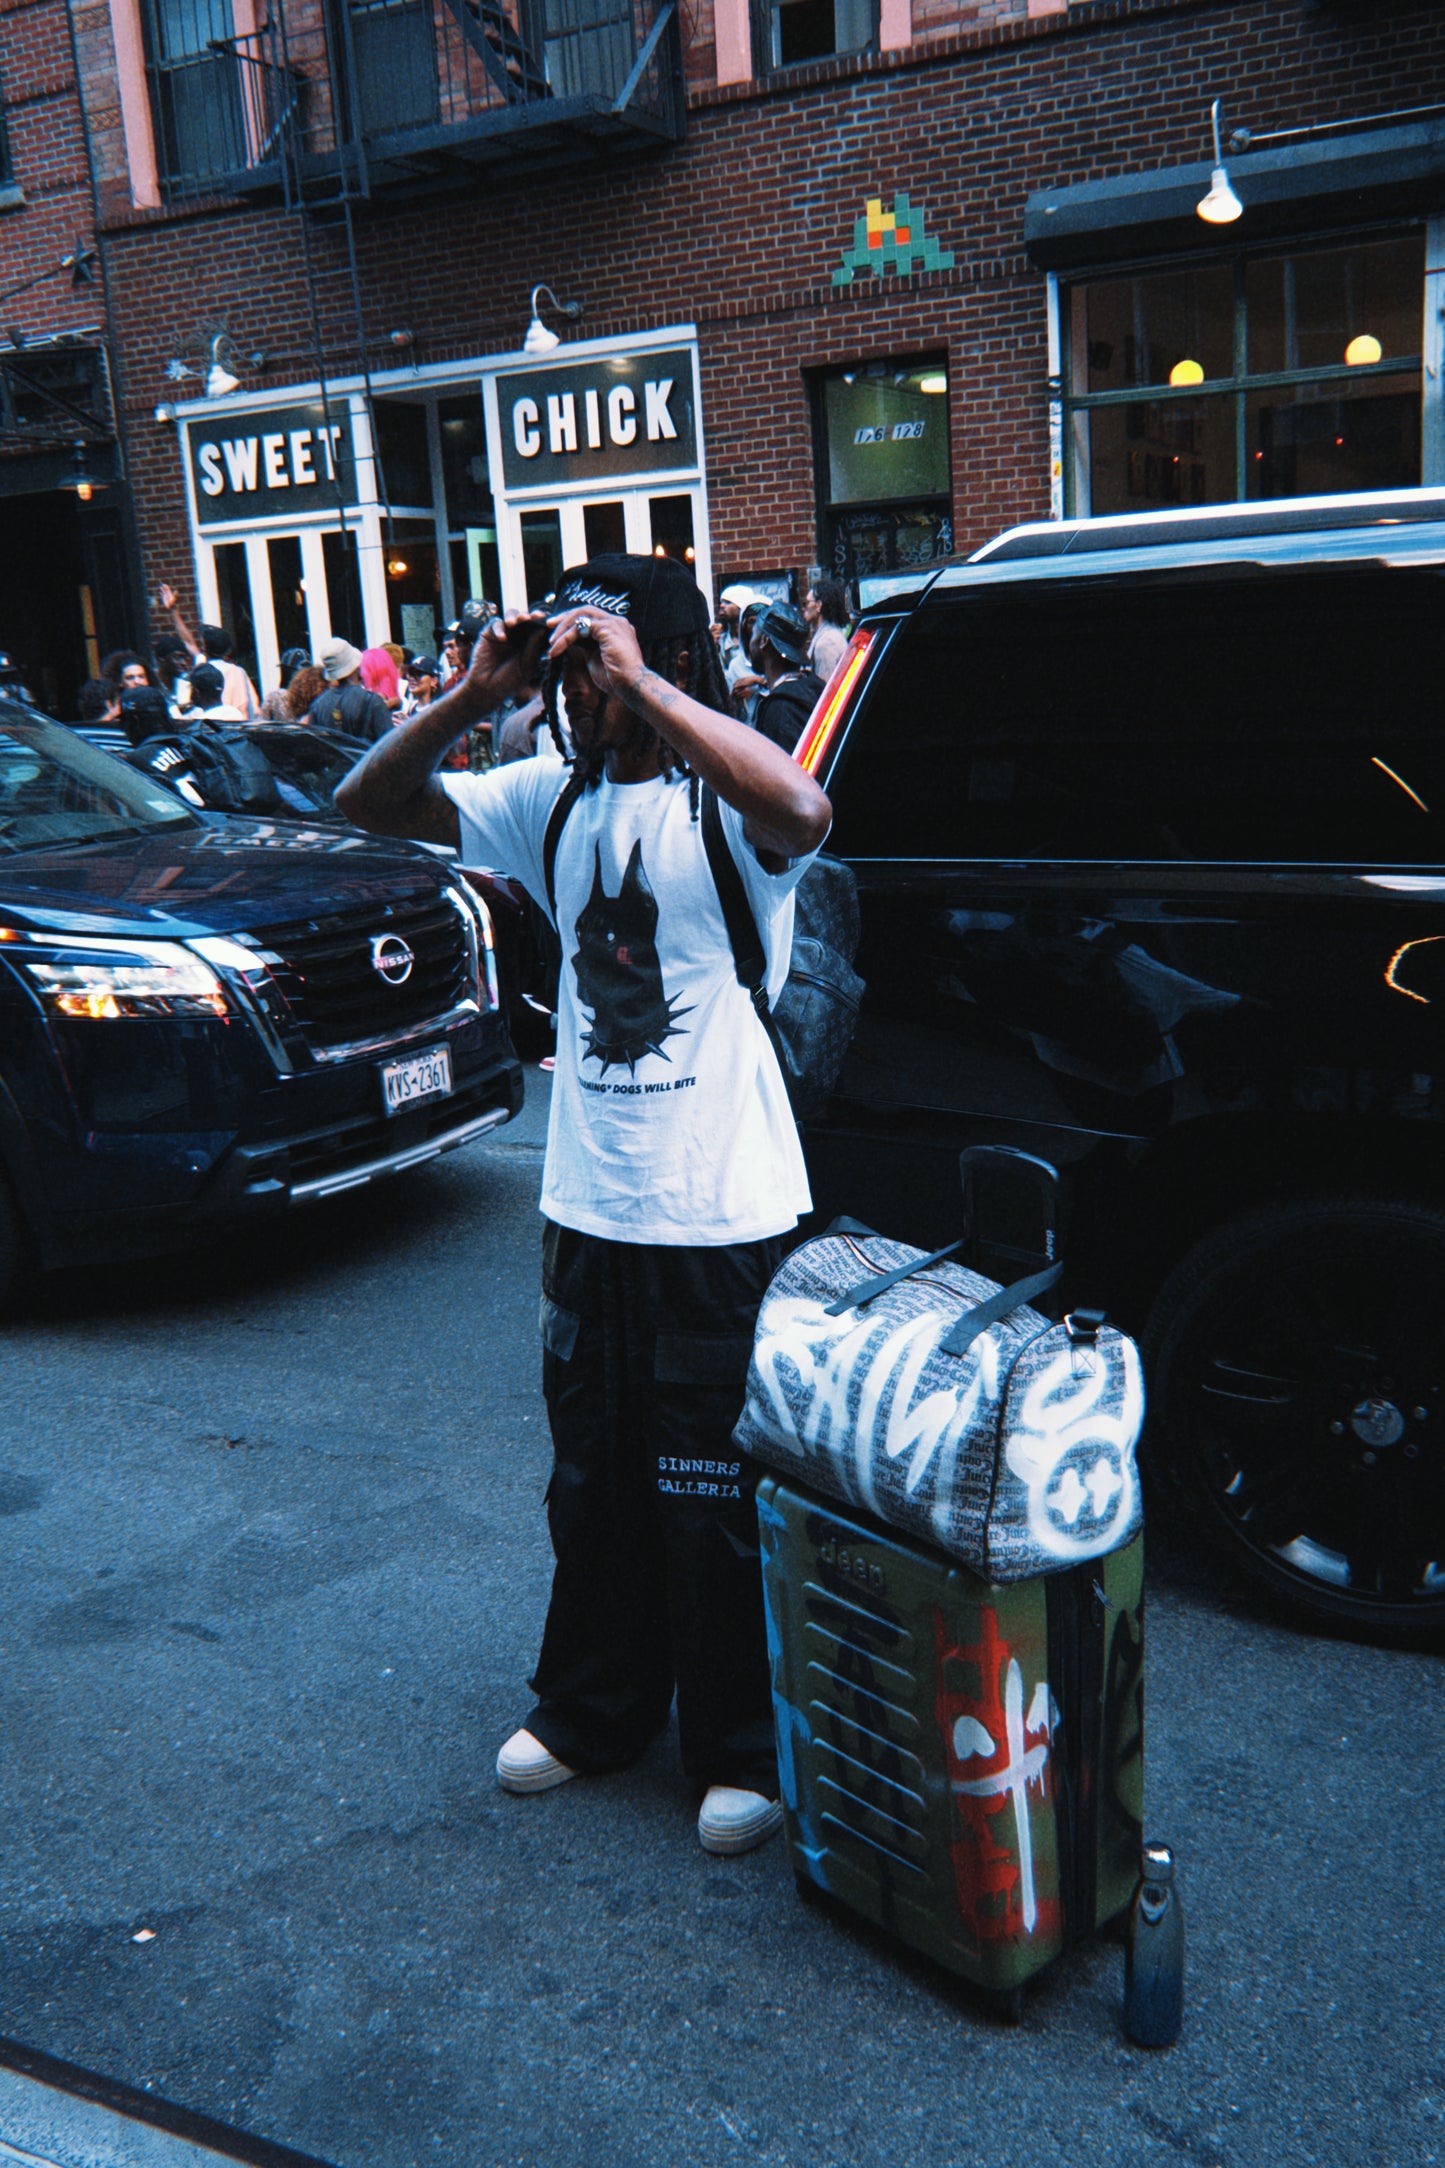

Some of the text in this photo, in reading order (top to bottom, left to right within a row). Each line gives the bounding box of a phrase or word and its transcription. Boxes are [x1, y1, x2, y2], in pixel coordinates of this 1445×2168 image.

[198, 377, 678, 496] SWEET CHICK
[374, 951, 415, 970] NISSAN
[613, 1084, 642, 1095] DOGS
[644, 1082, 672, 1093] WILL
[674, 1076, 697, 1090] BITE
[658, 1456, 741, 1476] SINNERS
[657, 1478, 741, 1499] GALLERIA
